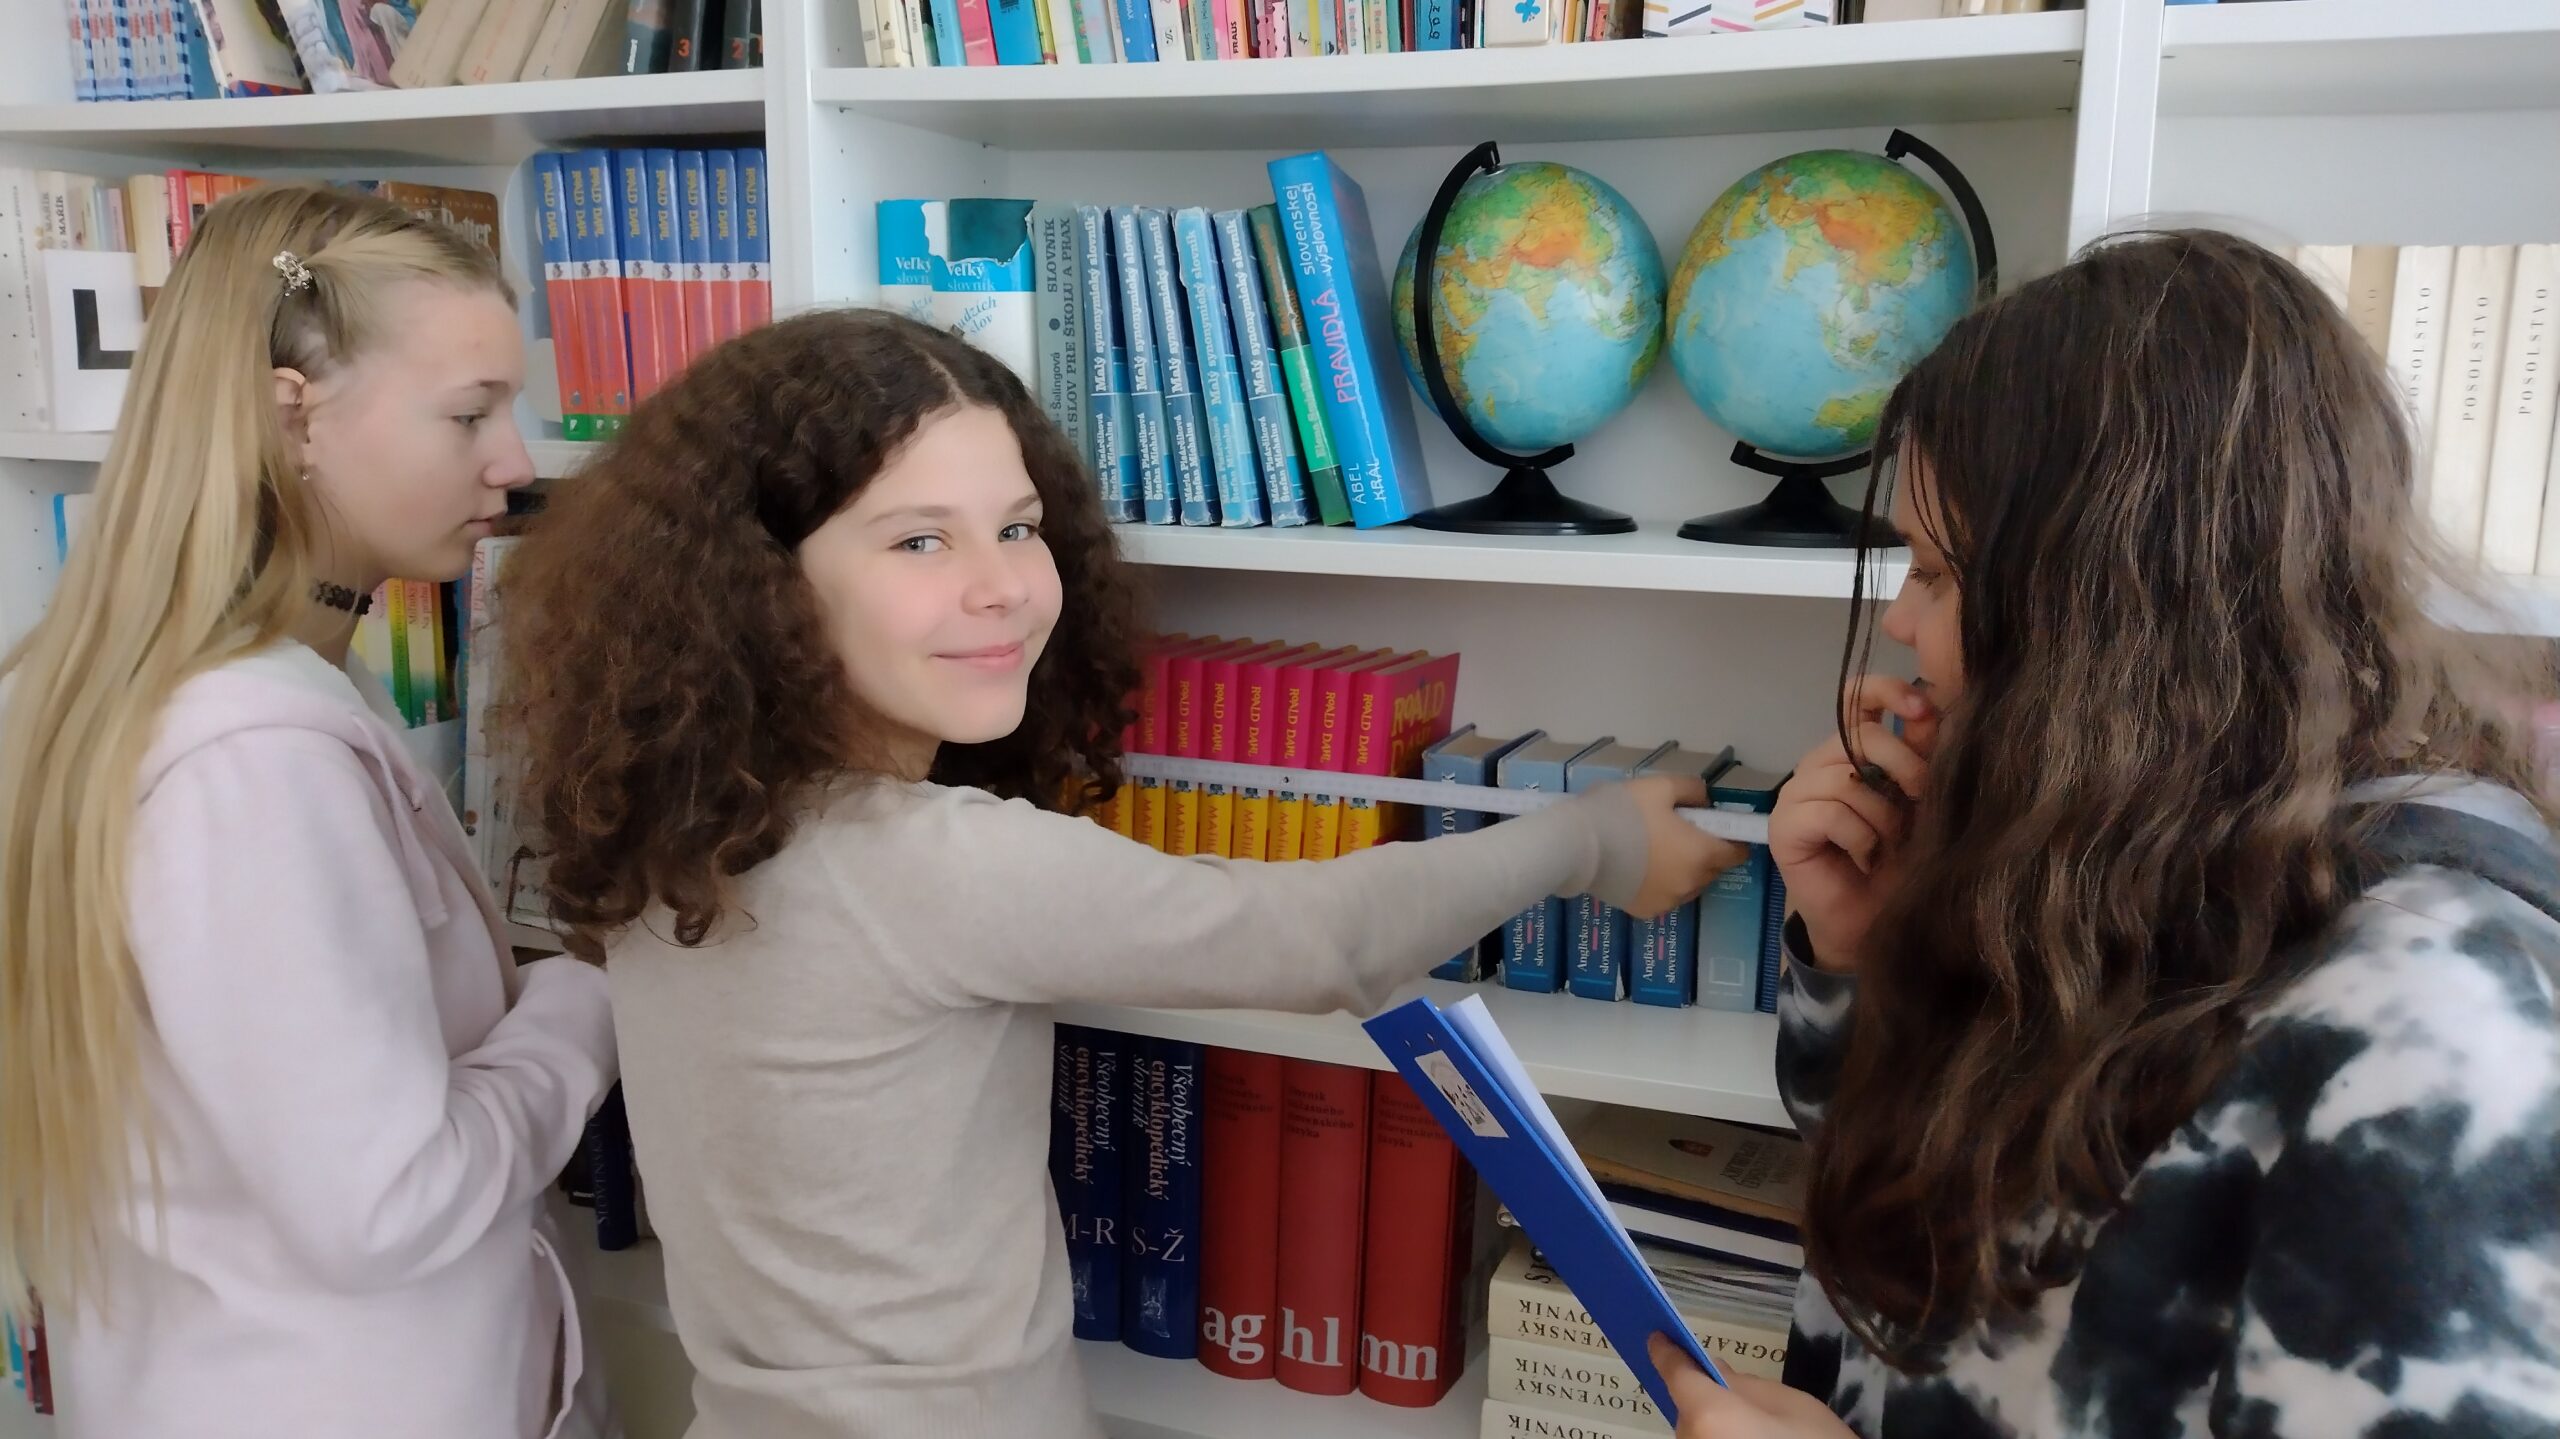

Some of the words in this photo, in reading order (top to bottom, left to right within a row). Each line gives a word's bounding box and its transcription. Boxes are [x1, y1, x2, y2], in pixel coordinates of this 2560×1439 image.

[1060, 217, 1072, 261] PRAX
[1084, 215, 1098, 265] slovník
[1120, 214, 1135, 264] slovník
[1149, 216, 1166, 266] slovník
[1186, 229, 1202, 279] slovník
[1226, 218, 1243, 269] slovník
[1283, 184, 1316, 276] slovenskej
[1301, 182, 1334, 277] výslovnosti
[896, 273, 931, 285] slovn
[1044, 217, 1058, 293] SLOVNÍK
[1063, 282, 1076, 337] ŠKOLU
[1088, 268, 1104, 353] synonymický
[1125, 266, 1144, 353] synonymický
[1157, 268, 1179, 354] synonymický
[1193, 281, 1216, 367] synonymický
[1234, 270, 1260, 356] synonymický
[1066, 342, 1077, 375] PRE
[1311, 287, 1356, 404] PRAVIDLÁ
[2462, 296, 2489, 421] POSOLSTVO
[2518, 288, 2547, 415] POSOLSTVO
[1094, 356, 1106, 392] Malý
[1135, 355, 1148, 392] Malý
[1169, 357, 1183, 394] Malý
[1207, 371, 1221, 406] Malý
[1251, 358, 1265, 396] Malý
[1067, 381, 1078, 423] SLOV
[1178, 680, 1190, 716] ROALD
[1213, 683, 1225, 719] ROALD
[1250, 686, 1261, 722] ROALD
[1287, 688, 1300, 725] ROALD
[1323, 691, 1336, 729] ROALD
[1361, 693, 1374, 731] ROALD
[1058, 1043, 1073, 1114] slovník
[1091, 1050, 1117, 1153] Všeobecný
[1132, 1054, 1149, 1129] slovník
[1070, 1046, 1095, 1185] encyklopedický
[1146, 1059, 1170, 1200] encyklopedický
[1170, 1064, 1194, 1167] Všeobecný
[1132, 1227, 1186, 1262] S-Ž
[1202, 1305, 1267, 1364] ag
[1281, 1306, 1345, 1368] hl
[1517, 1319, 1609, 1350] VENSKÝ
[1518, 1299, 1597, 1326] OVNÍK
[1361, 1329, 1438, 1381] mn
[1514, 1357, 1620, 1389] SLOVNÍK
[1514, 1377, 1652, 1415] SLOVENSKÝ
